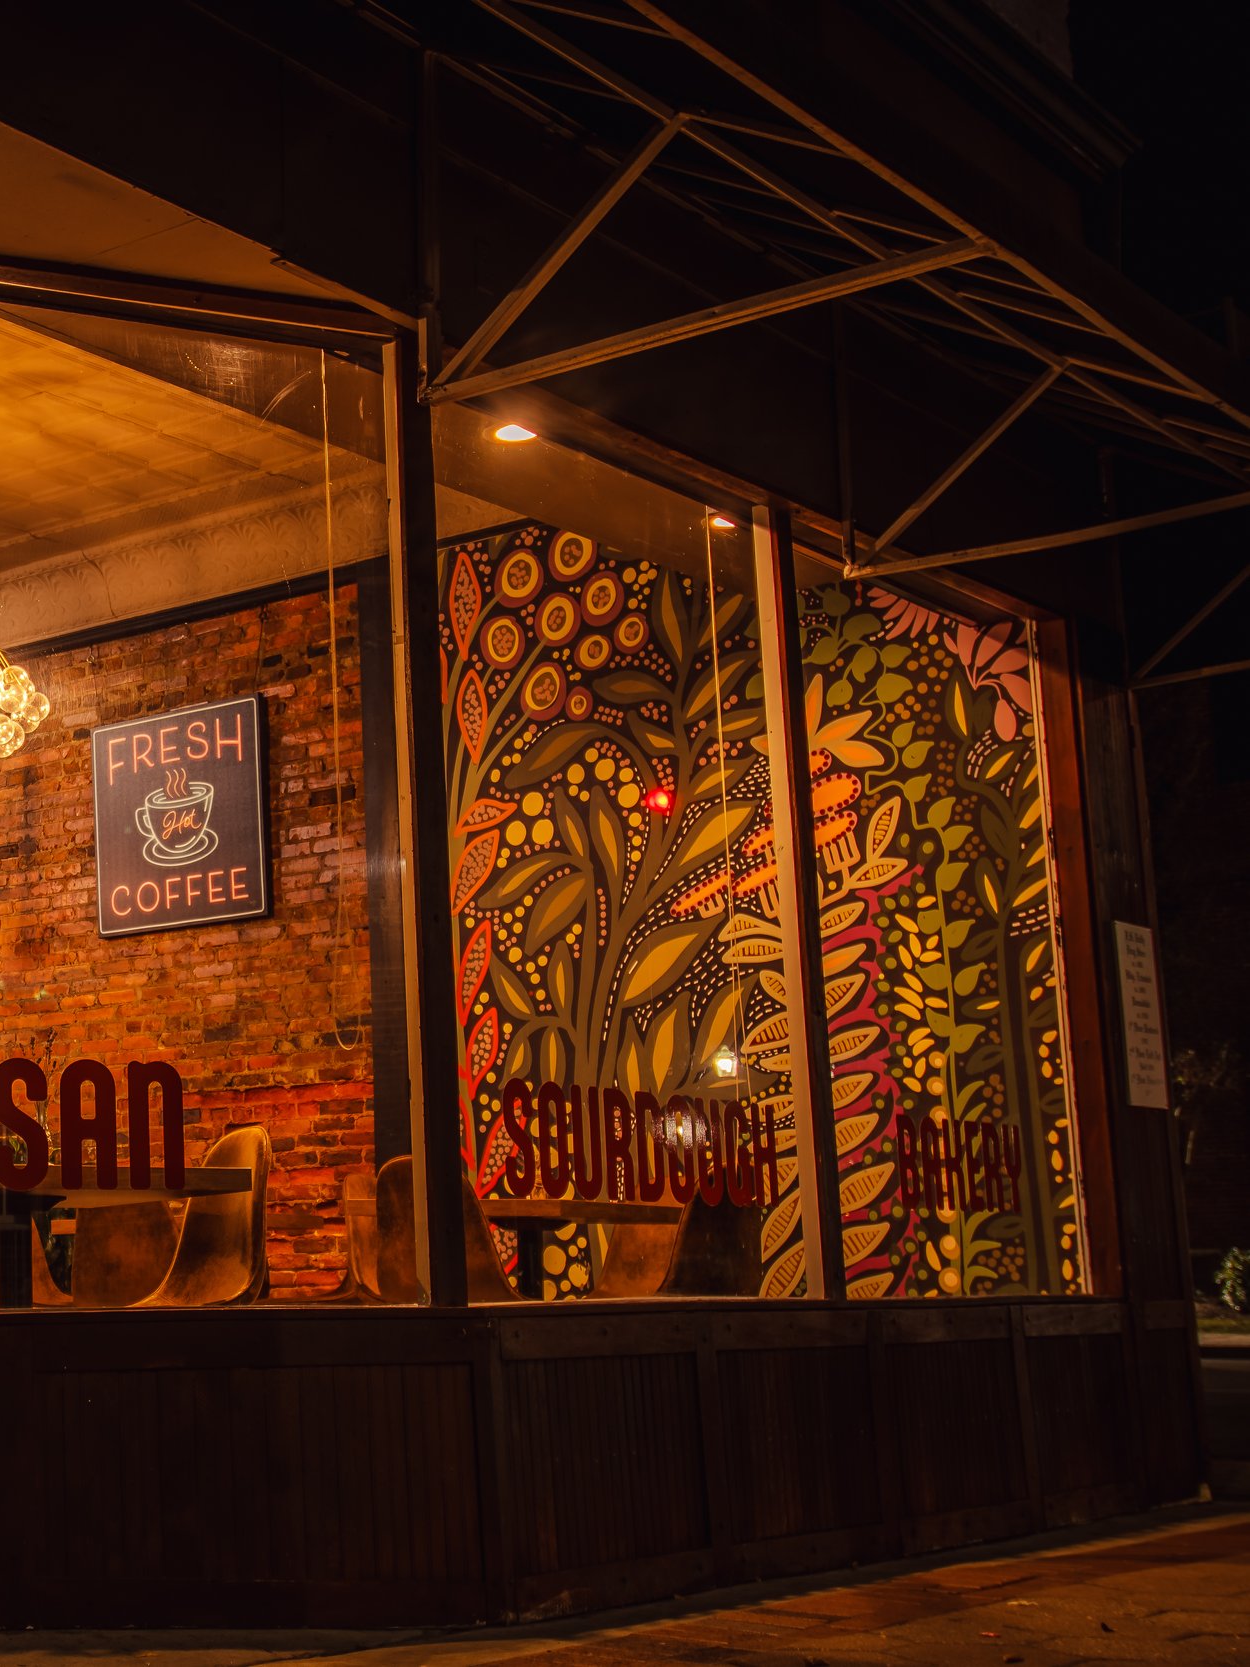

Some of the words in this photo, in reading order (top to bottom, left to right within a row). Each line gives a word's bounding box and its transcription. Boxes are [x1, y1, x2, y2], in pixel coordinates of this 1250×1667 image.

[108, 714, 244, 786] FRESH
[162, 809, 203, 840] Hot
[110, 867, 250, 916] COFFEE
[502, 1077, 780, 1208] SOURDOUGH
[895, 1114, 1022, 1213] BAKERY
